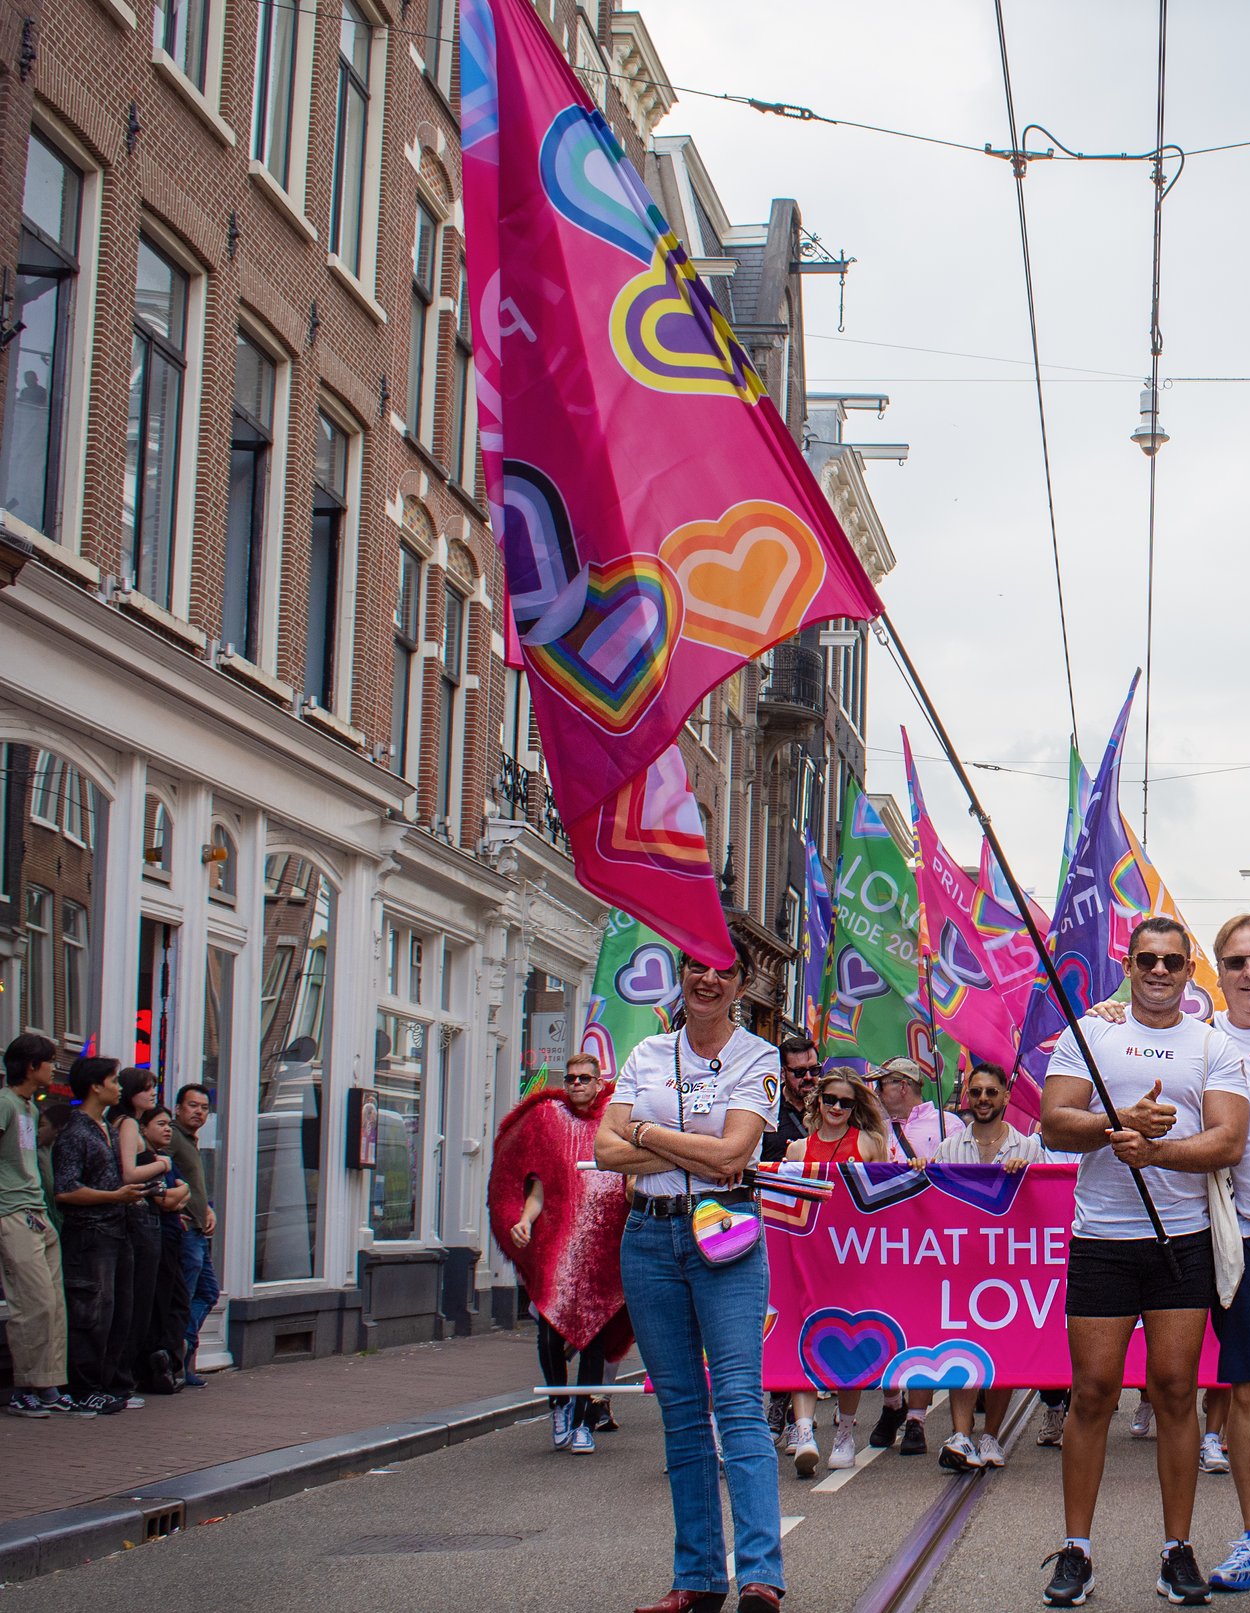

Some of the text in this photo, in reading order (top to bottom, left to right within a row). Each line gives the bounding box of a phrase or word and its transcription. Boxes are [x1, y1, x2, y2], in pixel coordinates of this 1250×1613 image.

[837, 854, 920, 931] LOV
[1125, 1046, 1174, 1060] #LOVE
[828, 1226, 1066, 1265] WHAT THE
[940, 1278, 1068, 1330] LOV
